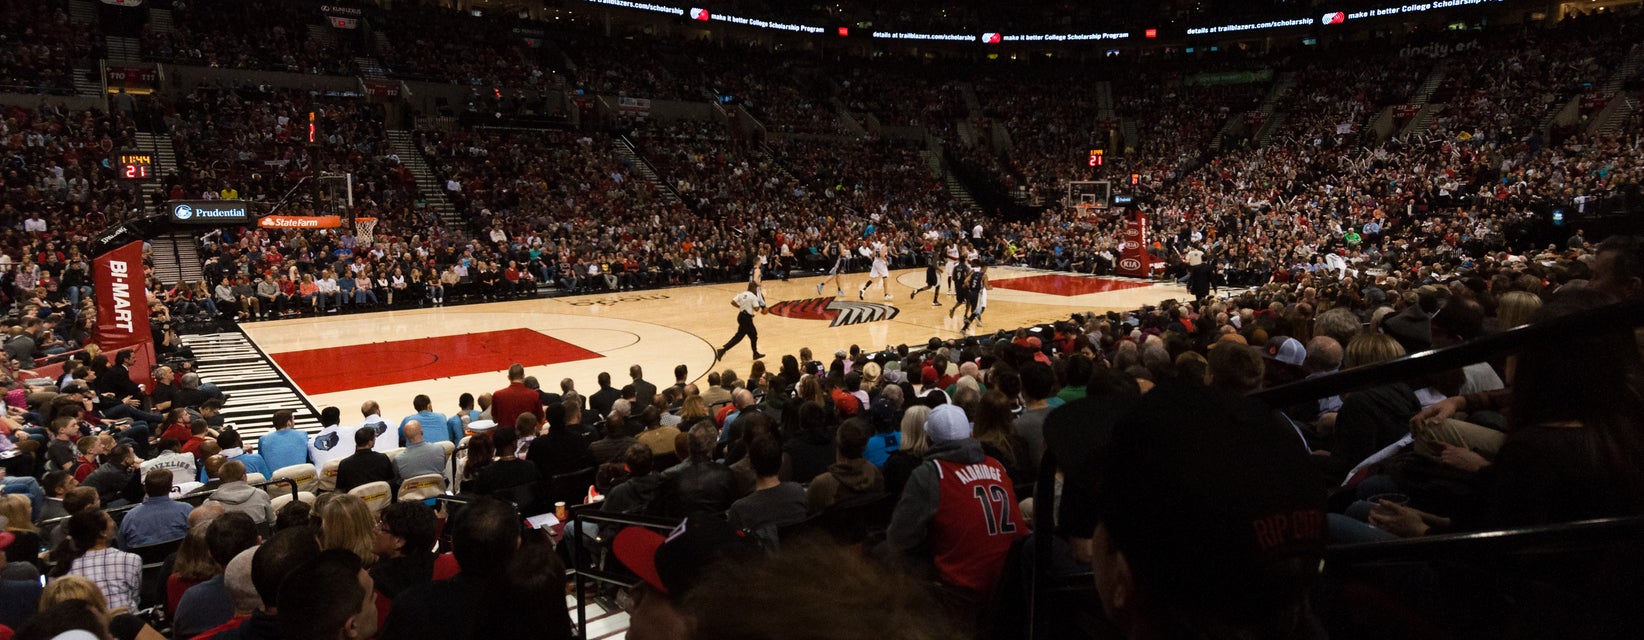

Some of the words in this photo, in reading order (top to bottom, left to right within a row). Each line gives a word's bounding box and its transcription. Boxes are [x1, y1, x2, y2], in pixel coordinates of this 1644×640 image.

[1377, 7, 1400, 16] better
[1402, 3, 1431, 12] College
[711, 13, 727, 21] make
[732, 16, 748, 24] better
[749, 18, 768, 28] College
[769, 21, 800, 32] Scholarship
[800, 25, 825, 33] Program
[1218, 17, 1314, 32] trailblazers.com/scholarship
[899, 32, 976, 42] trailblazers.com/scholarship
[1067, 33, 1102, 41] Scholarship
[1102, 32, 1129, 40] Program
[122, 155, 151, 164] 11:44
[1089, 155, 1102, 166] 21
[126, 165, 146, 178] 21
[195, 208, 245, 217] Prudential
[110, 260, 134, 333] BI-MART
[147, 460, 191, 473] RIZZLIES
[955, 464, 1002, 485] ALDRIDGE
[974, 484, 1016, 536] 12
[1252, 513, 1289, 549] RIP
